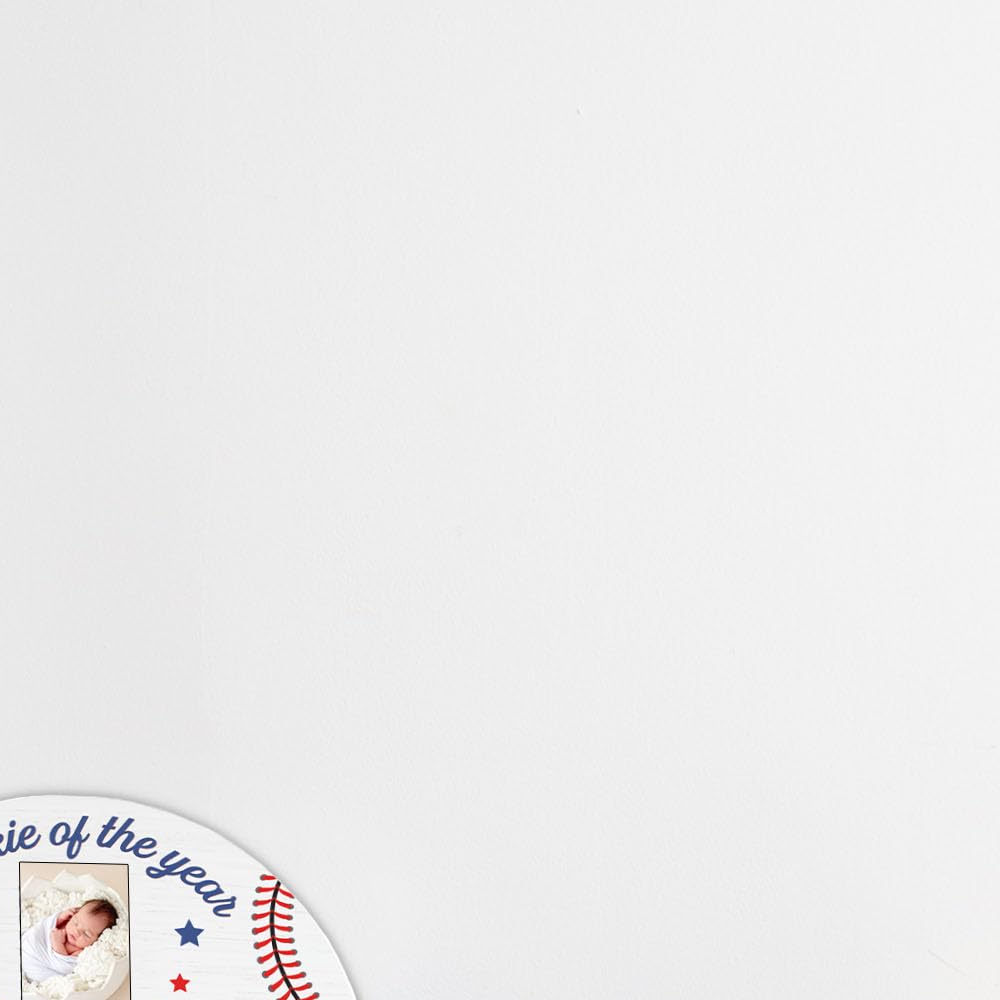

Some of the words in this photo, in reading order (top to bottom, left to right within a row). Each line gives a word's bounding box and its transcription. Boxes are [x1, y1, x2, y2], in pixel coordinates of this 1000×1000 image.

[49, 814, 89, 860] of
[96, 814, 157, 858] the
[145, 850, 236, 917] year
